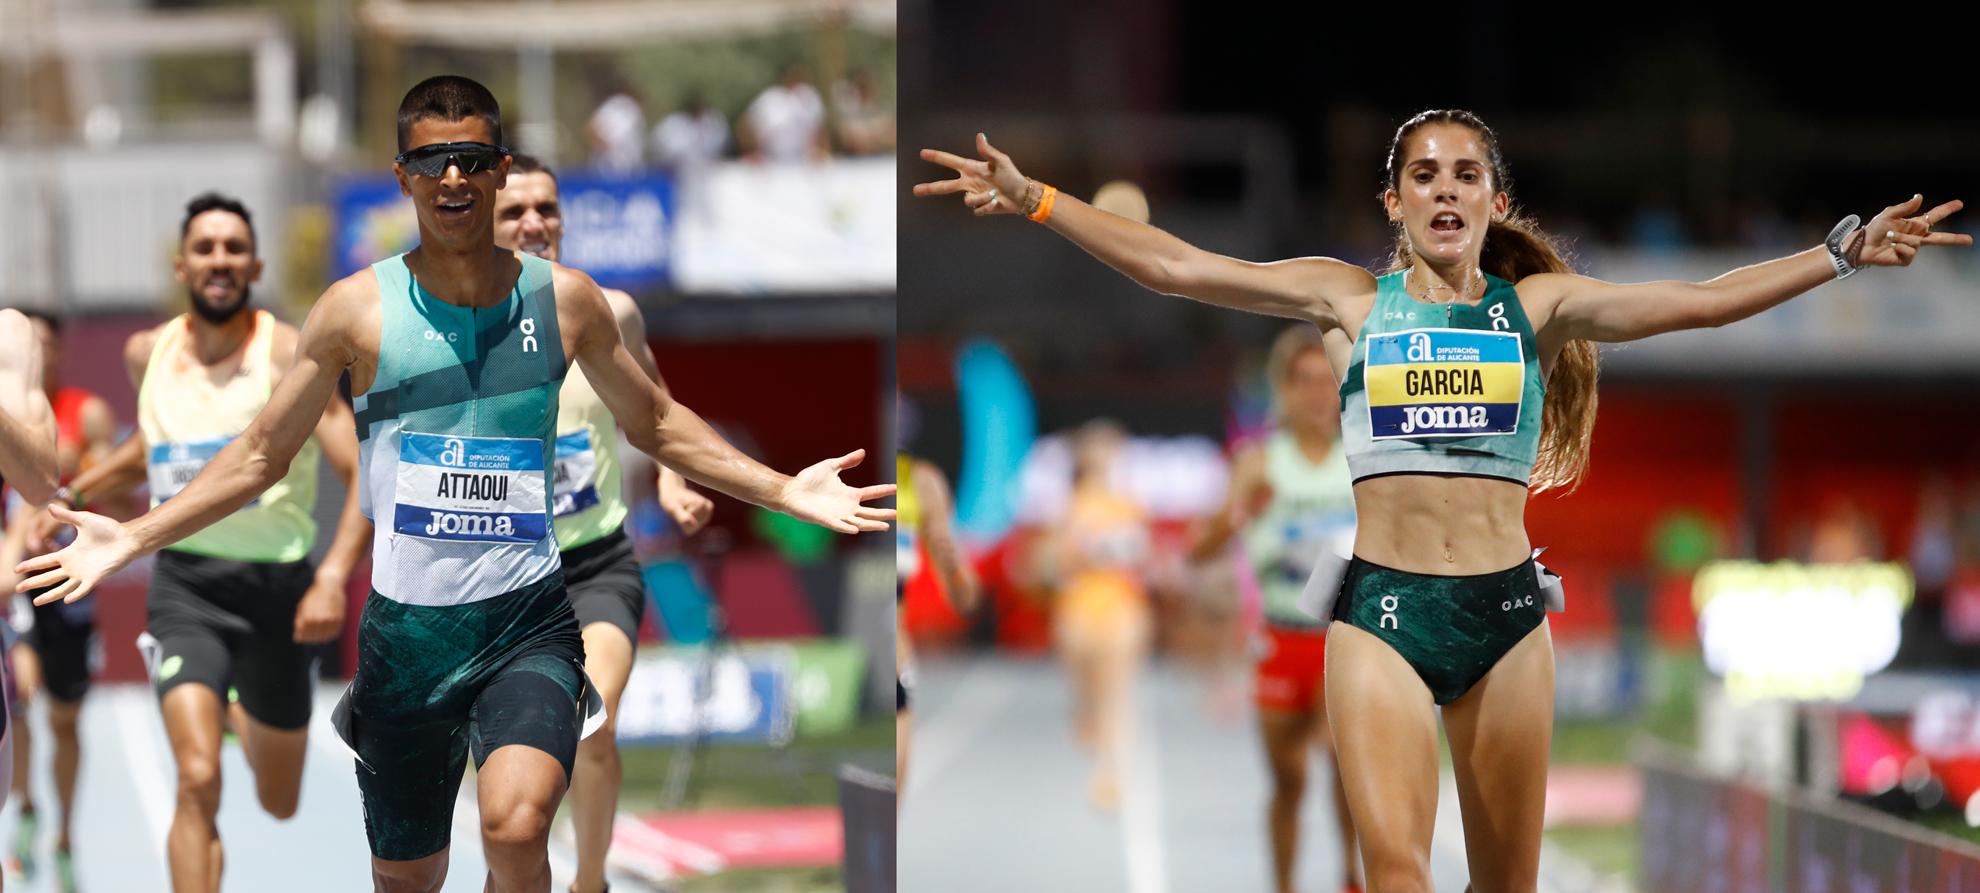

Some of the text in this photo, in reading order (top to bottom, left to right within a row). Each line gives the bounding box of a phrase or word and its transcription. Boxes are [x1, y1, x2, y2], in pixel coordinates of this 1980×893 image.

[1384, 311, 1416, 320] OAC
[424, 330, 457, 342] OAC
[1436, 346, 1480, 355] DIPUTACIÓN
[1406, 368, 1484, 396] GARCIA
[469, 454, 511, 462] DIPUTACIÓN
[478, 461, 510, 469] ALICANTE
[437, 472, 508, 501] ATTAOUI
[1501, 594, 1534, 612] OAC
